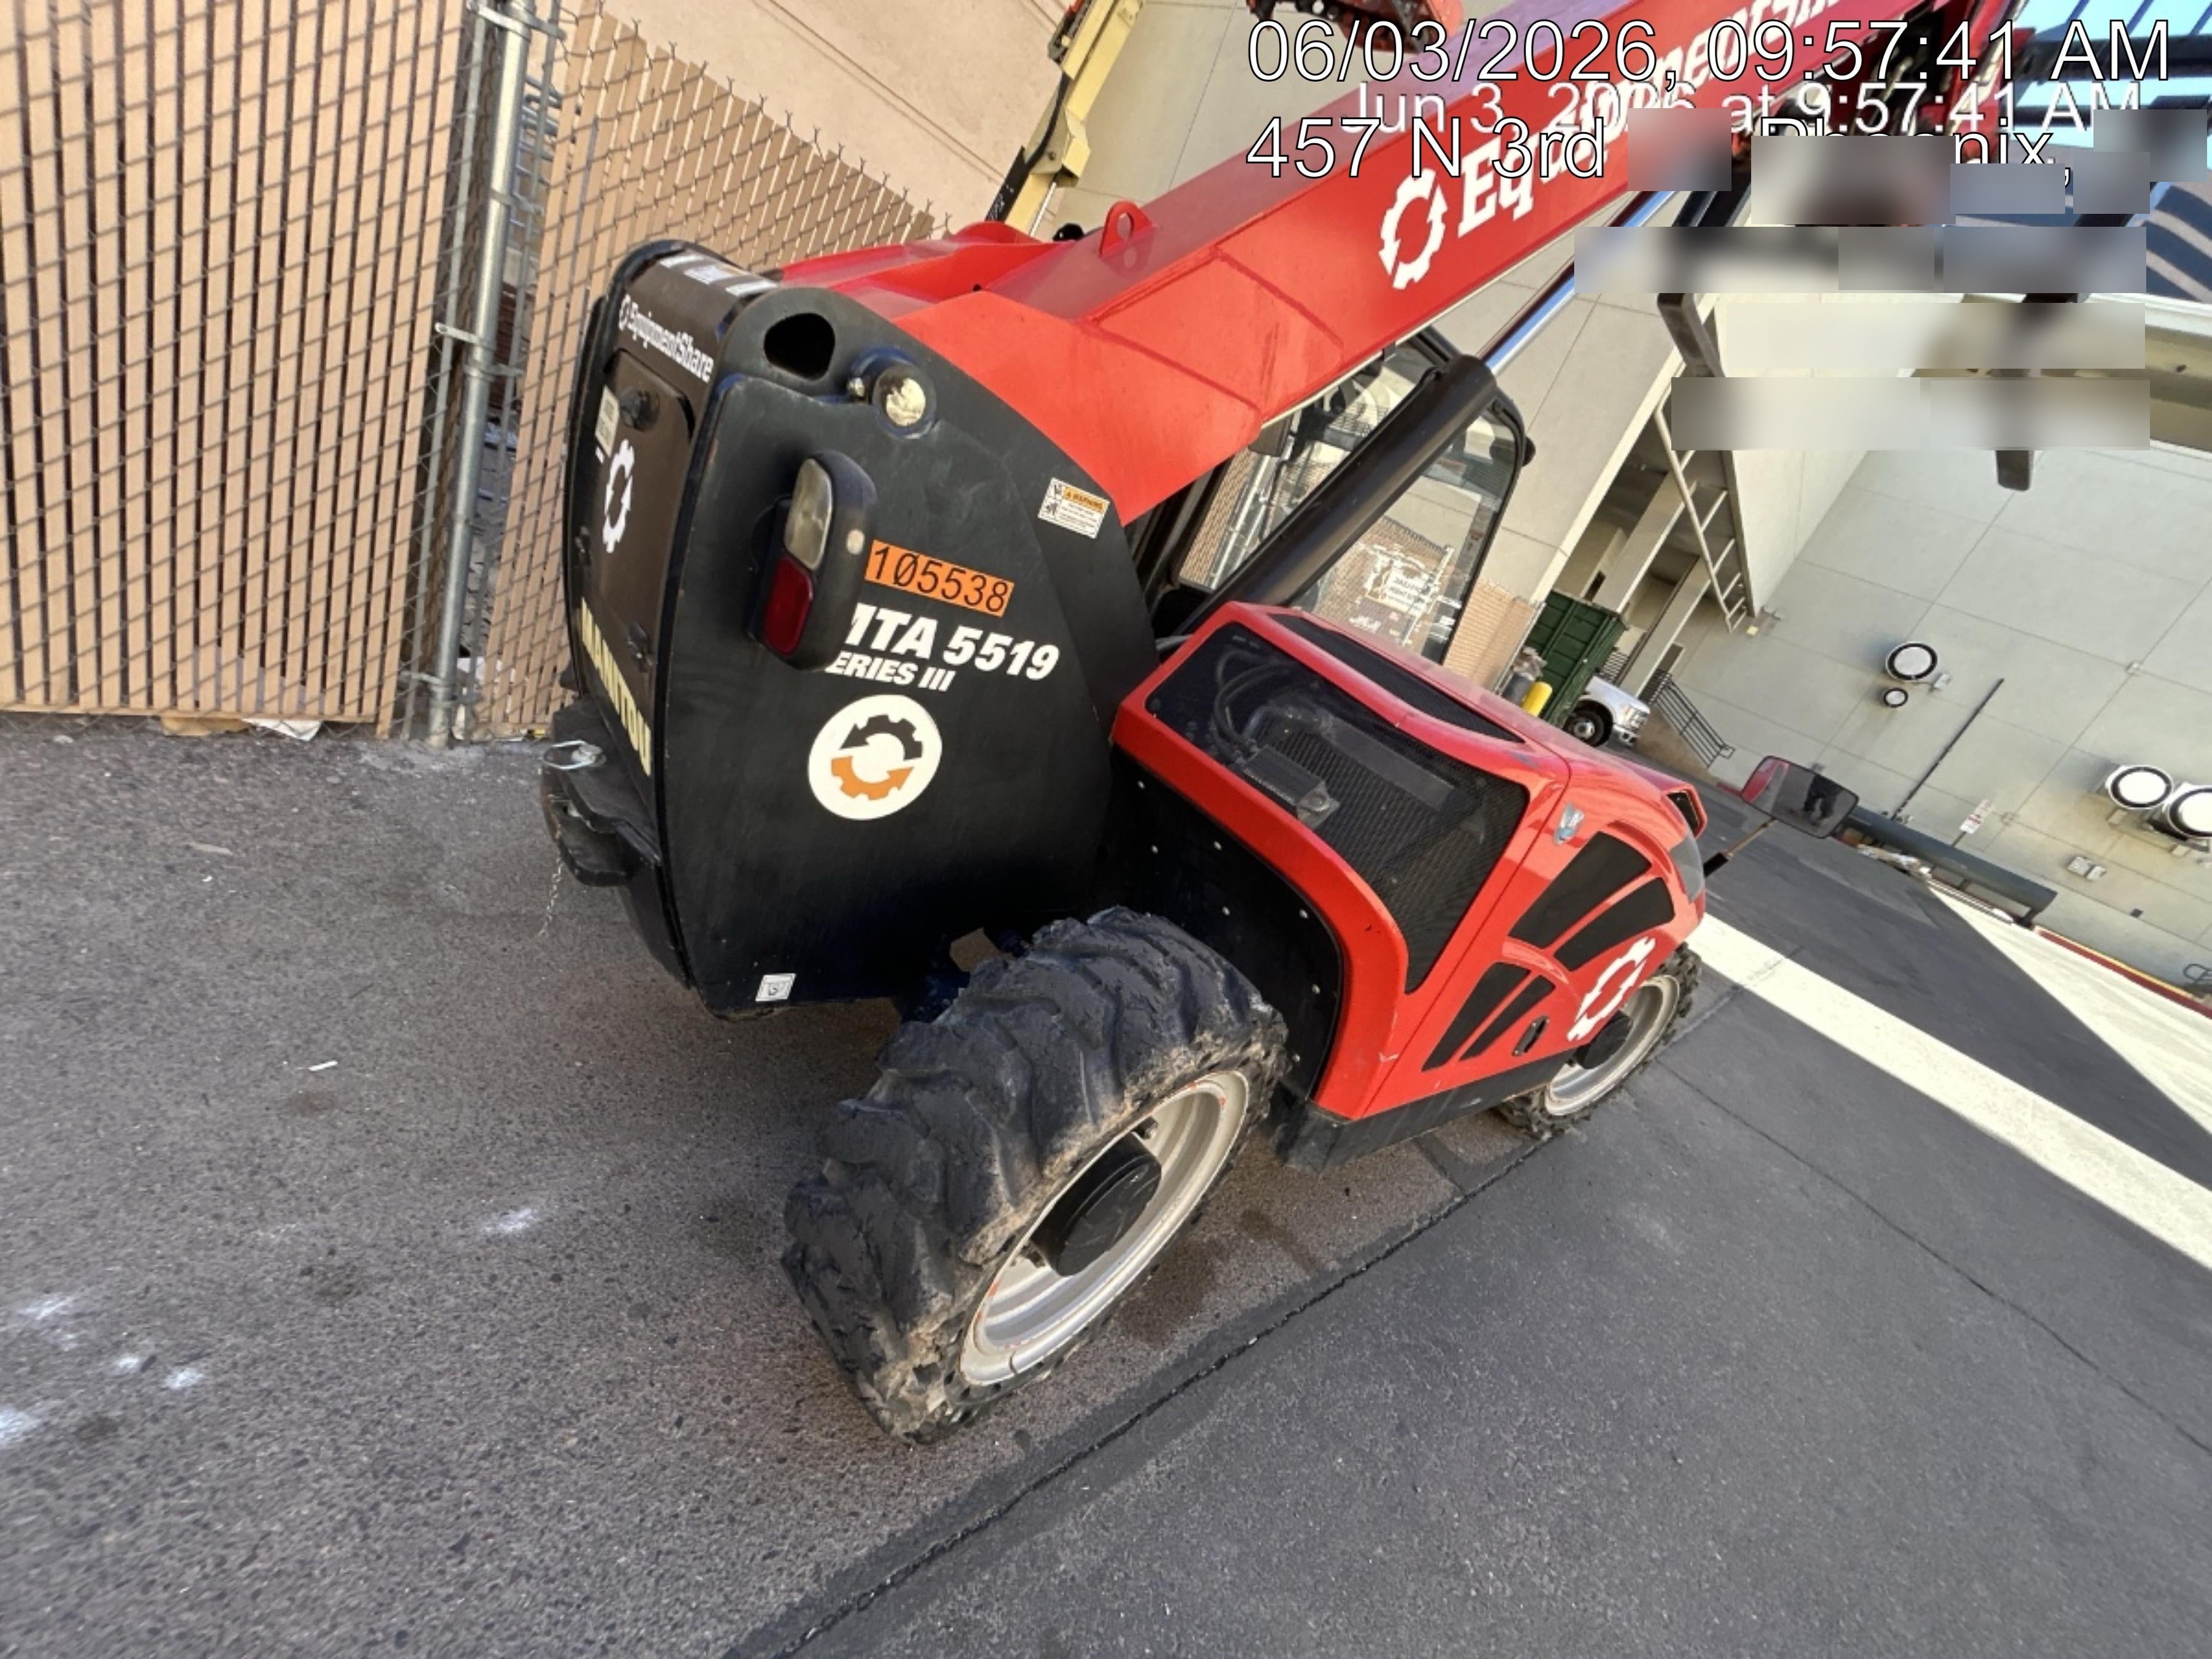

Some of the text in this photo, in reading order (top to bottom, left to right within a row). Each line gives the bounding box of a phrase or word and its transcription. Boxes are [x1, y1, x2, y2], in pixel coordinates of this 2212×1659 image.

[874, 546, 1009, 613] 105538
[825, 650, 957, 692] ERIES III
[943, 624, 1060, 680] 5519
[581, 595, 652, 777] MANITOU
